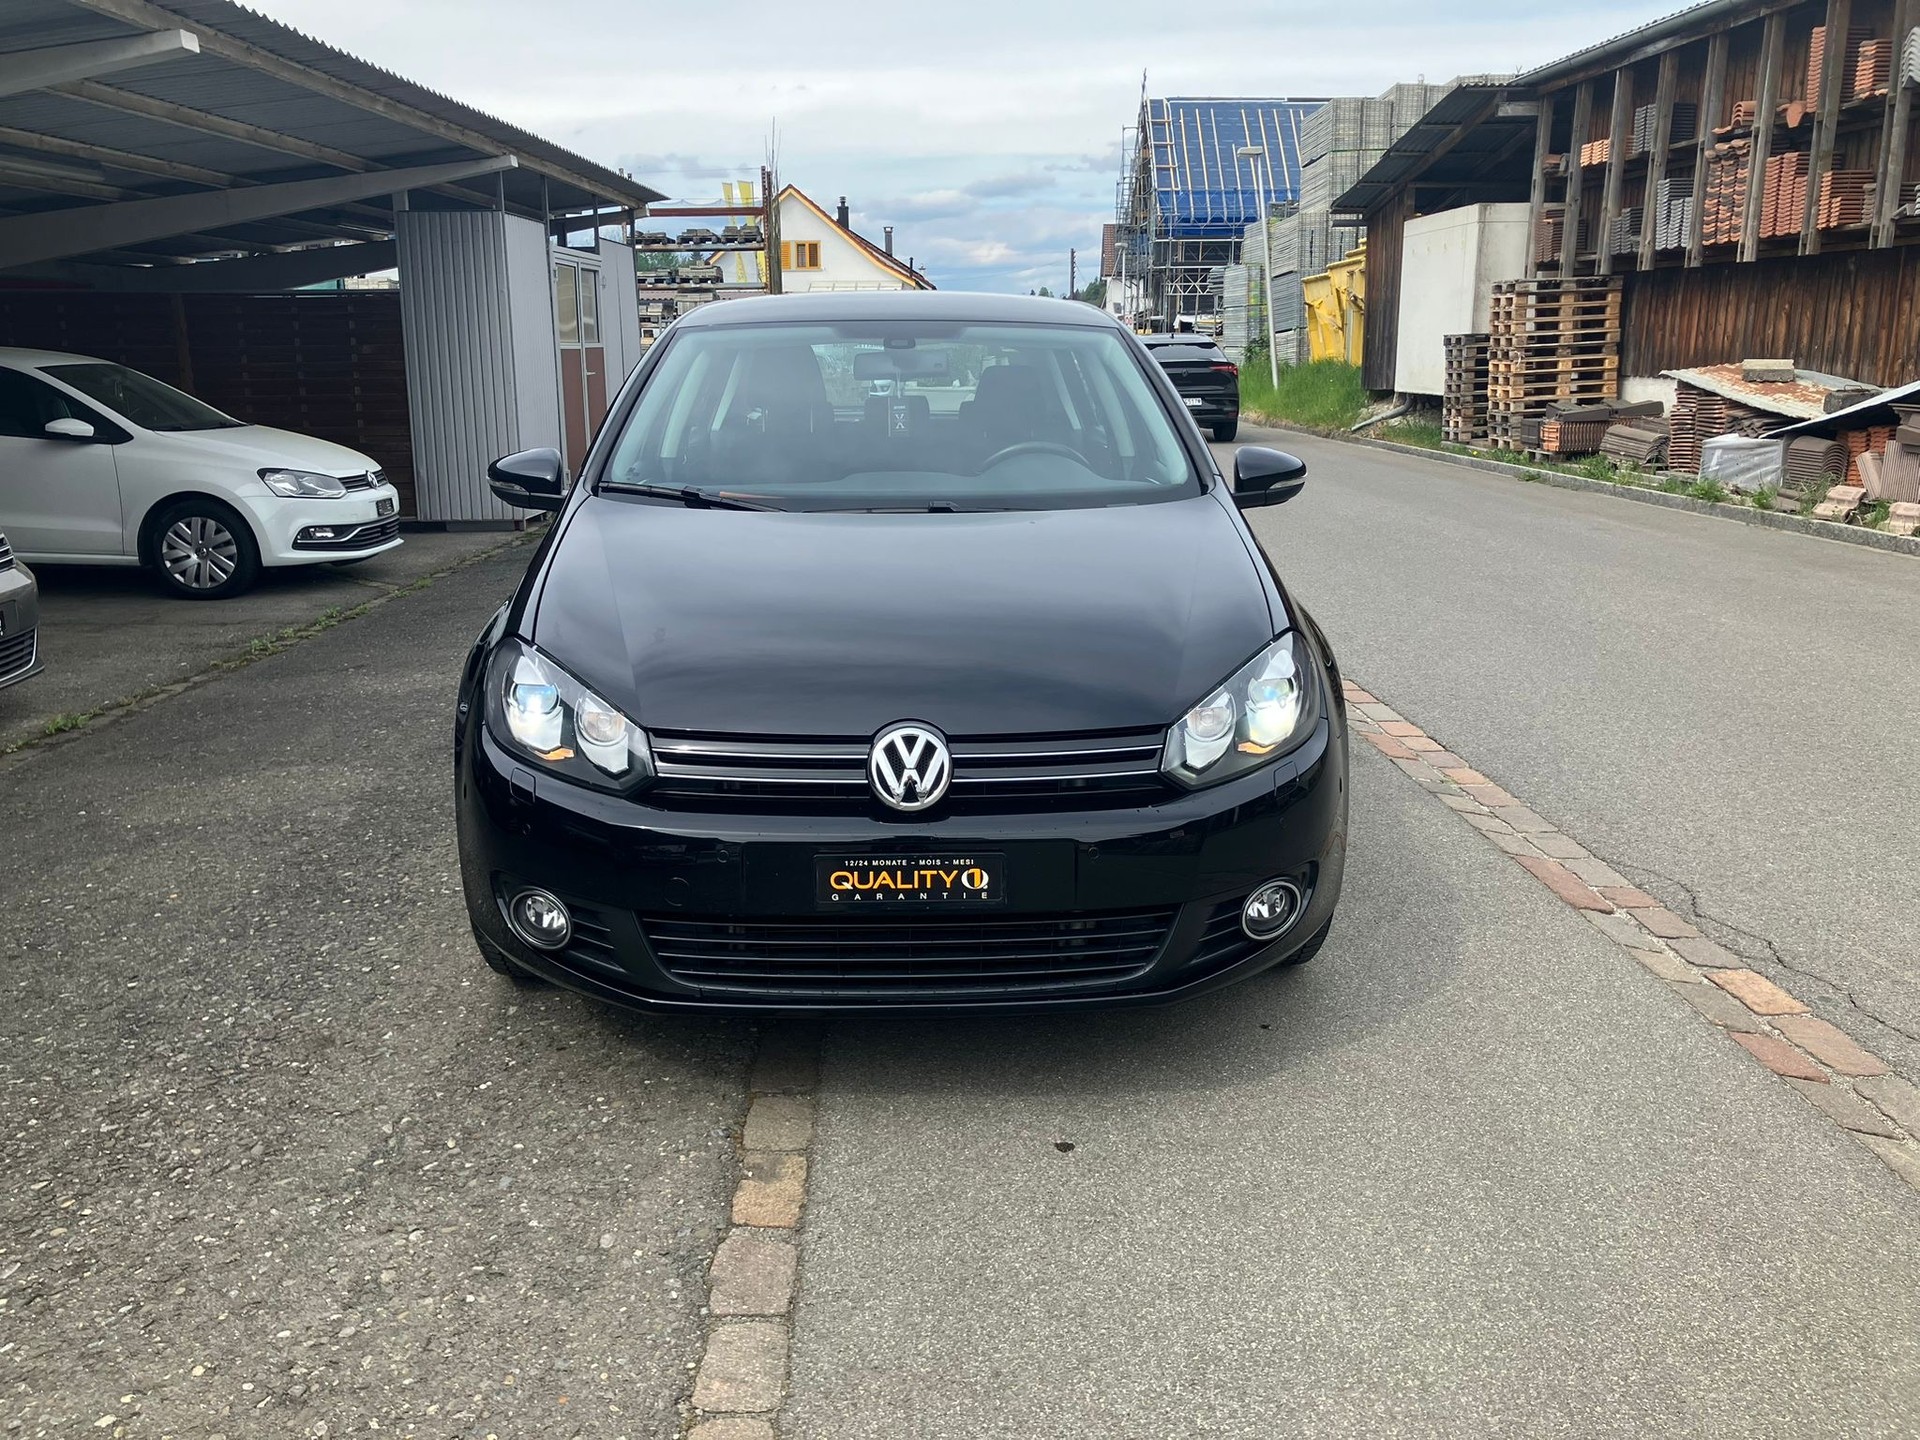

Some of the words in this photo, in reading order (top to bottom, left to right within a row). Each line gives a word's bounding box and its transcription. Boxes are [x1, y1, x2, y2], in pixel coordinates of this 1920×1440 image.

[844, 859, 869, 867] 12/24
[918, 858, 942, 866] MOIS
[952, 858, 975, 866] MESI
[829, 869, 959, 890] QUALITY
[831, 891, 988, 901] GARANTIE
